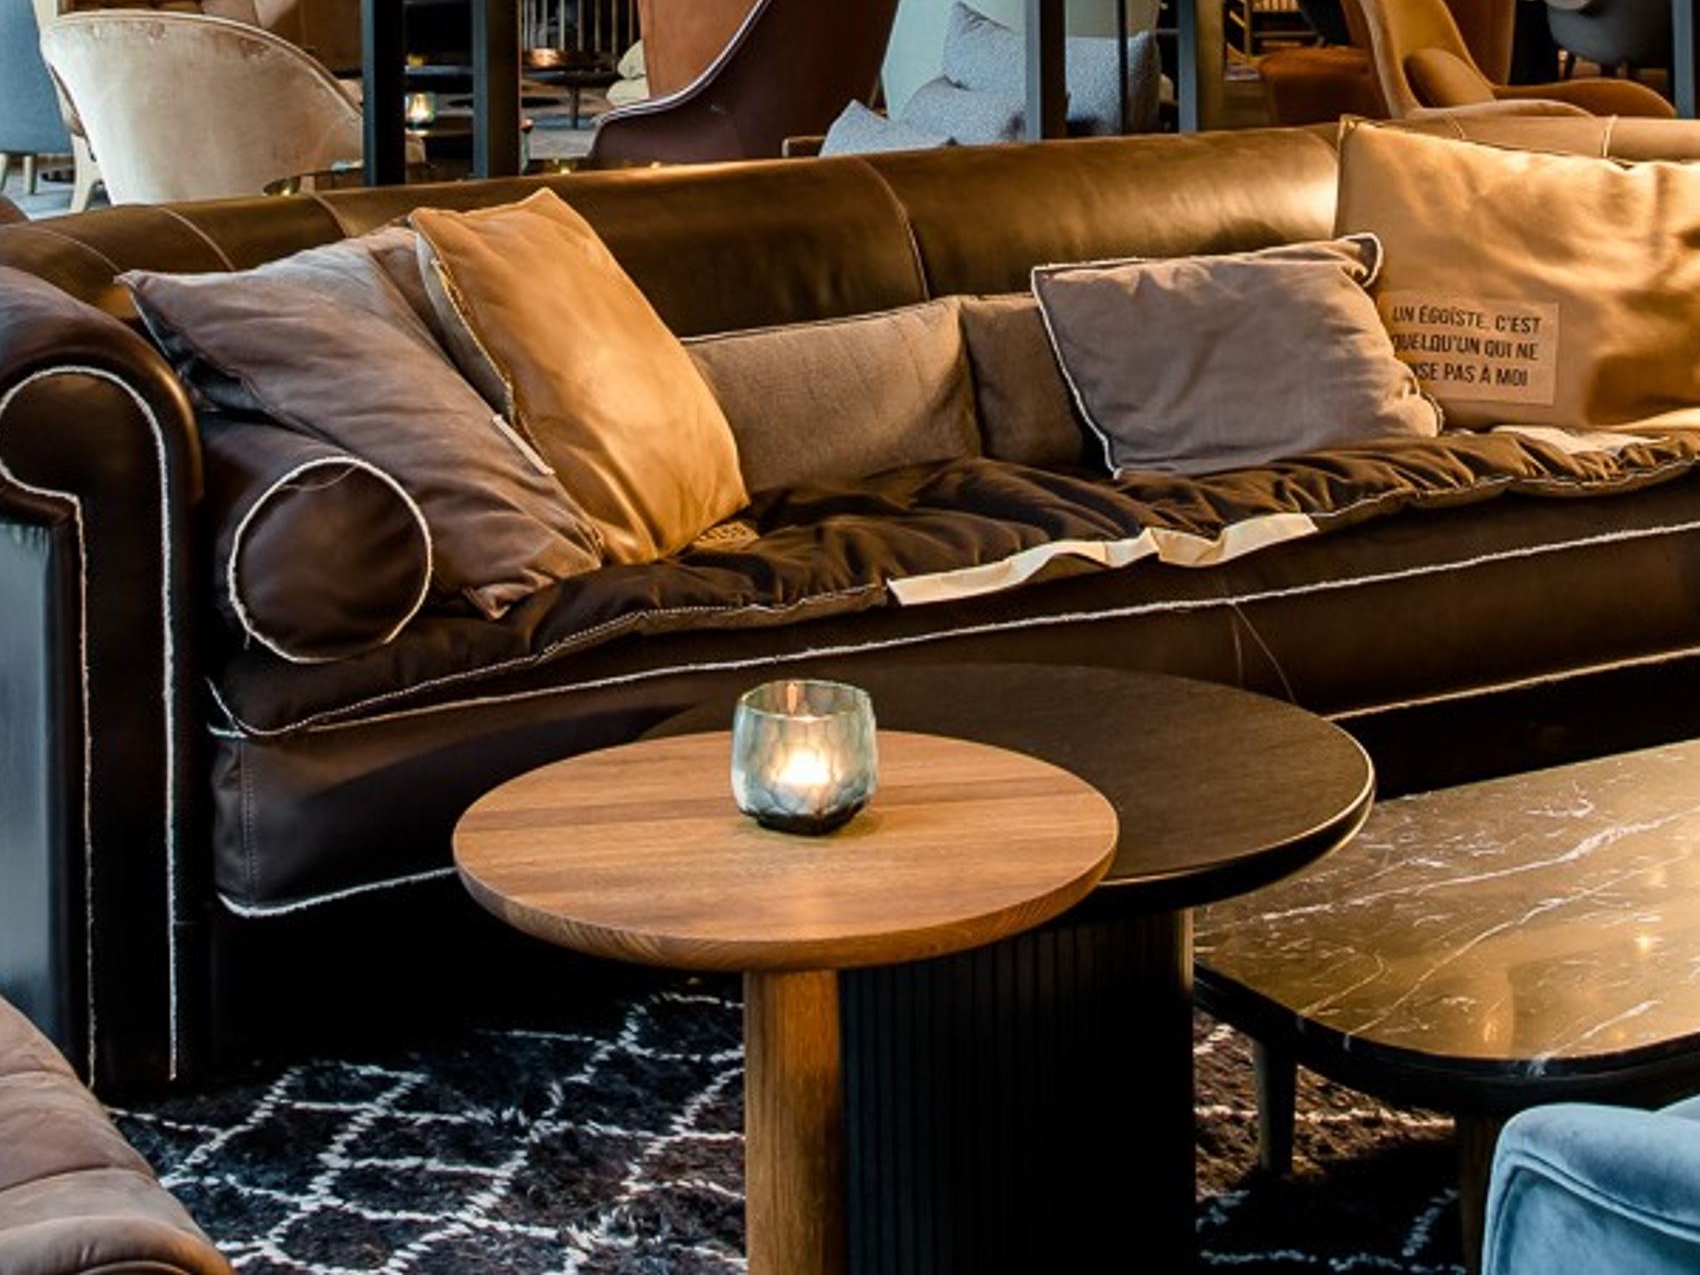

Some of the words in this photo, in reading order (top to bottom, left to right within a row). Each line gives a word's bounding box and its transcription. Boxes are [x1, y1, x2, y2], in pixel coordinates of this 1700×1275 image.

[1393, 305, 1415, 322] UN
[1495, 314, 1542, 334] C'EST
[1485, 339, 1512, 358] QUI
[1516, 342, 1539, 360] NE
[1444, 362, 1477, 383] PAS
[1496, 368, 1528, 386] MOI
